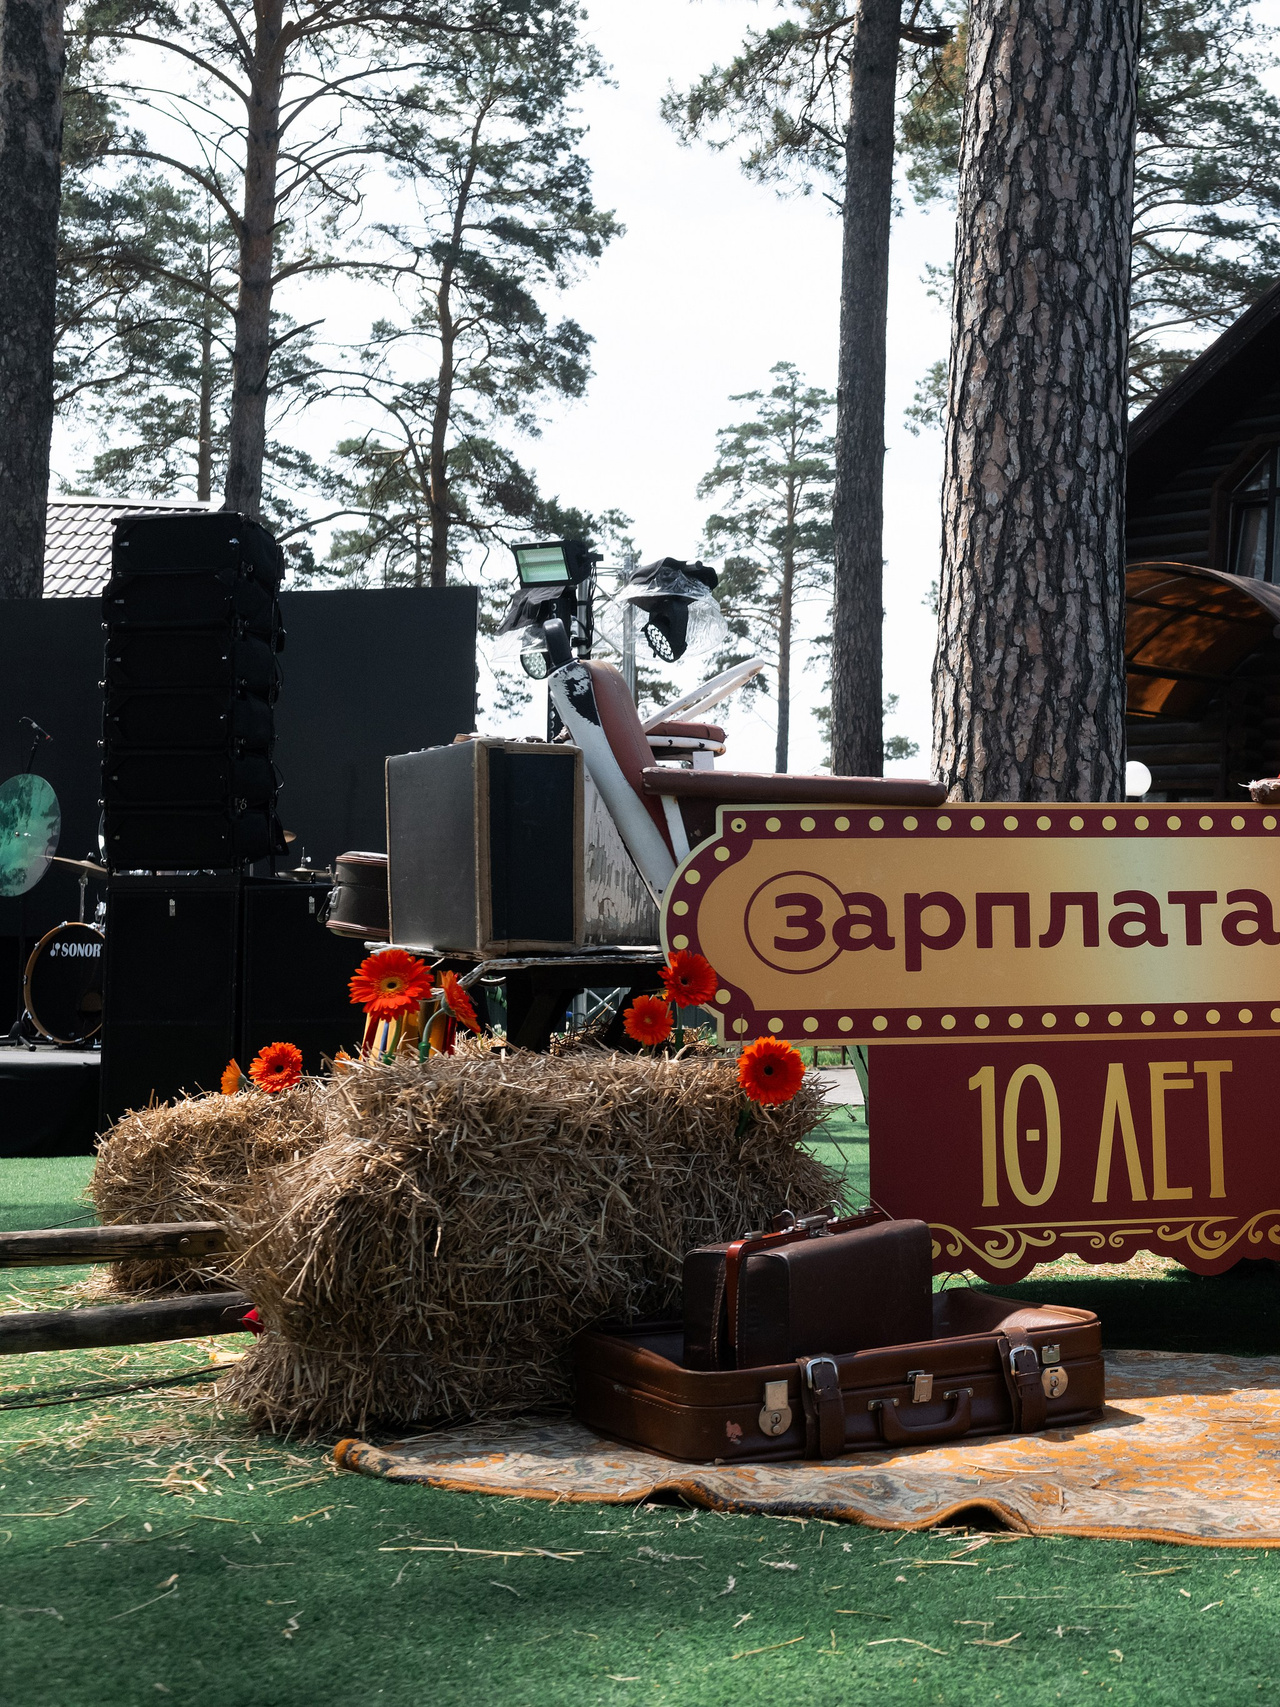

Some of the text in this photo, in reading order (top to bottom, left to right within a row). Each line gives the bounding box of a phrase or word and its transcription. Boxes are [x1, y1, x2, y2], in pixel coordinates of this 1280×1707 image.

[61, 942, 101, 957] SONOR
[968, 1060, 1233, 1207] 10 ЛЕТ
